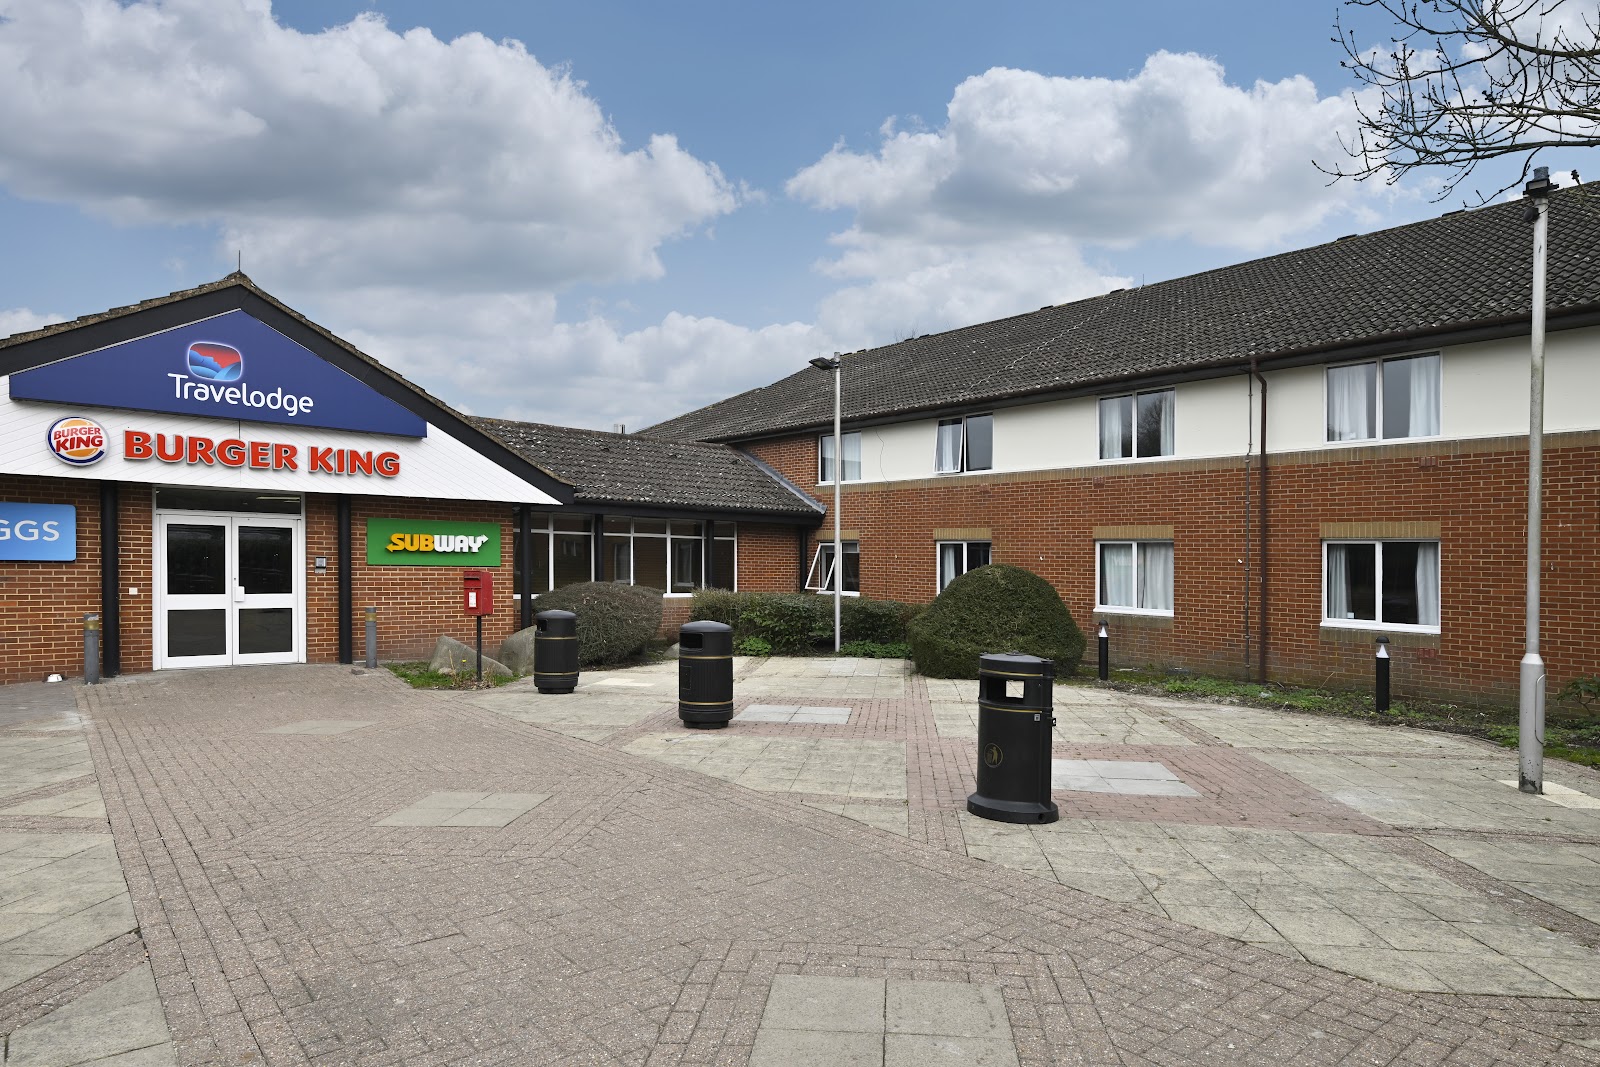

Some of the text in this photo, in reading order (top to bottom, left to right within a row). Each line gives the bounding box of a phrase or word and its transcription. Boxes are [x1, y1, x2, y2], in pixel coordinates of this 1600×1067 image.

[167, 373, 314, 417] Travelodge
[53, 427, 101, 440] BURGER
[56, 435, 103, 453] KING
[123, 430, 401, 477] BURGER KING
[385, 533, 489, 552] SUBWAY
